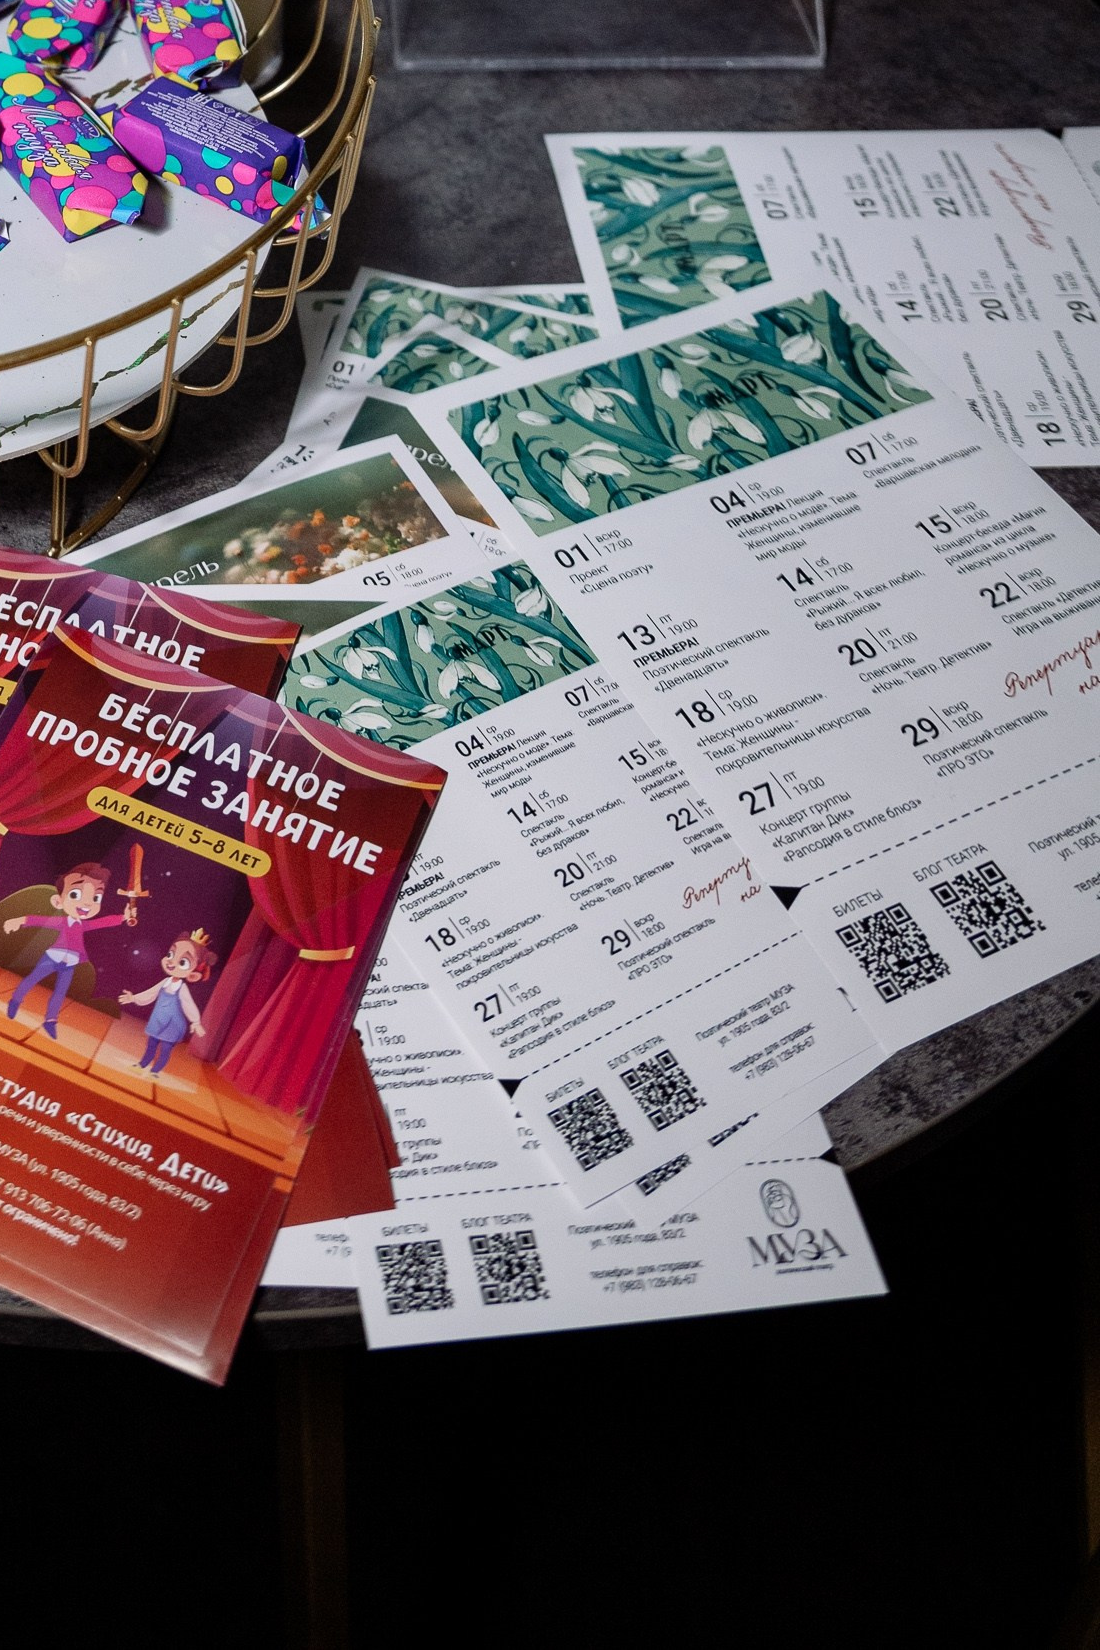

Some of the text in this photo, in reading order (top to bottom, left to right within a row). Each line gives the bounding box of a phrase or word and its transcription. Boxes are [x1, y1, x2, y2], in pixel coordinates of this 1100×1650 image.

[12, 95, 99, 181] Маленькая
[13, 123, 60, 168] пауза
[980, 299, 1009, 322] 20
[701, 372, 778, 408] МАРТ
[1037, 421, 1065, 447] 18
[845, 441, 877, 466] 07
[709, 490, 747, 514] 04
[756, 485, 785, 502] 19:00
[725, 490, 824, 529] ПРЕМЬЕРА! Лекция
[915, 514, 952, 539] 15
[554, 543, 590, 569] 01
[603, 537, 633, 554] 17:00
[568, 565, 609, 584] Проект
[580, 564, 654, 595] «Сцена поэту»
[776, 567, 815, 592] 14
[824, 562, 854, 578] 17:00
[793, 584, 850, 608] Спектакль
[979, 581, 1021, 609] 22
[667, 618, 699, 636] 19:00
[814, 601, 882, 631] без дураков»
[449, 626, 513, 660] МАРТ
[617, 624, 656, 651] 13
[837, 638, 877, 666] 20
[887, 631, 918, 650] 21:00
[632, 636, 700, 669] ПРЕМЬЕРА!
[642, 628, 770, 681] Поэтический спектакль
[654, 659, 729, 693] «Двенадцать»
[858, 657, 916, 683] Спектакль
[871, 641, 992, 694] «Ночь. Театр. Детектив»
[564, 684, 590, 707] 07
[726, 694, 759, 712] 19:00
[674, 700, 715, 729] 18
[696, 693, 823, 748] «Нескучно о живописи».
[951, 710, 984, 729] 18:00
[454, 734, 484, 757] 04
[715, 707, 872, 776] покровительницы искусства
[900, 717, 940, 748] 29
[922, 709, 1049, 766] Поэтический спектакль
[98, 693, 346, 811] БЕСПЛАТНОЕ
[617, 748, 648, 771] 15
[936, 749, 995, 778] «ПРО ЭТО»
[27, 711, 383, 875] ПРОБНОЕ ЗАНЯТИЕ
[738, 781, 775, 816] 27
[792, 776, 825, 796] 19:00
[506, 800, 538, 824] 14
[666, 807, 699, 832] 22
[758, 791, 852, 836] Концерт группы
[96, 796, 130, 816] ДЛЯ
[132, 809, 184, 839] ДЕТЕЙ
[229, 849, 262, 870] ЛЕТ
[772, 809, 855, 848] «Капитан Дик»
[783, 798, 922, 863] «Рапсодия в стиле блюз»
[553, 862, 585, 888] 20
[912, 843, 989, 883] БЛОГ ТЕАТРА
[408, 889, 468, 923] «Двенадцать»
[832, 889, 884, 918] БИЛЕТЫ
[424, 927, 457, 952] 18
[600, 929, 632, 956] 29
[473, 992, 502, 1023] 27
[65, 1111, 155, 1163] «Стихия.
[157, 1152, 229, 1194] Дети»
[27, 1157, 49, 1176] (ул.
[50, 1168, 81, 1190] 1905
[77, 1183, 109, 1205] года,
[107, 1196, 142, 1220] 83/2)
[381, 1223, 429, 1237] БИЛЕТЫ
[747, 1228, 848, 1269] МУЗА
